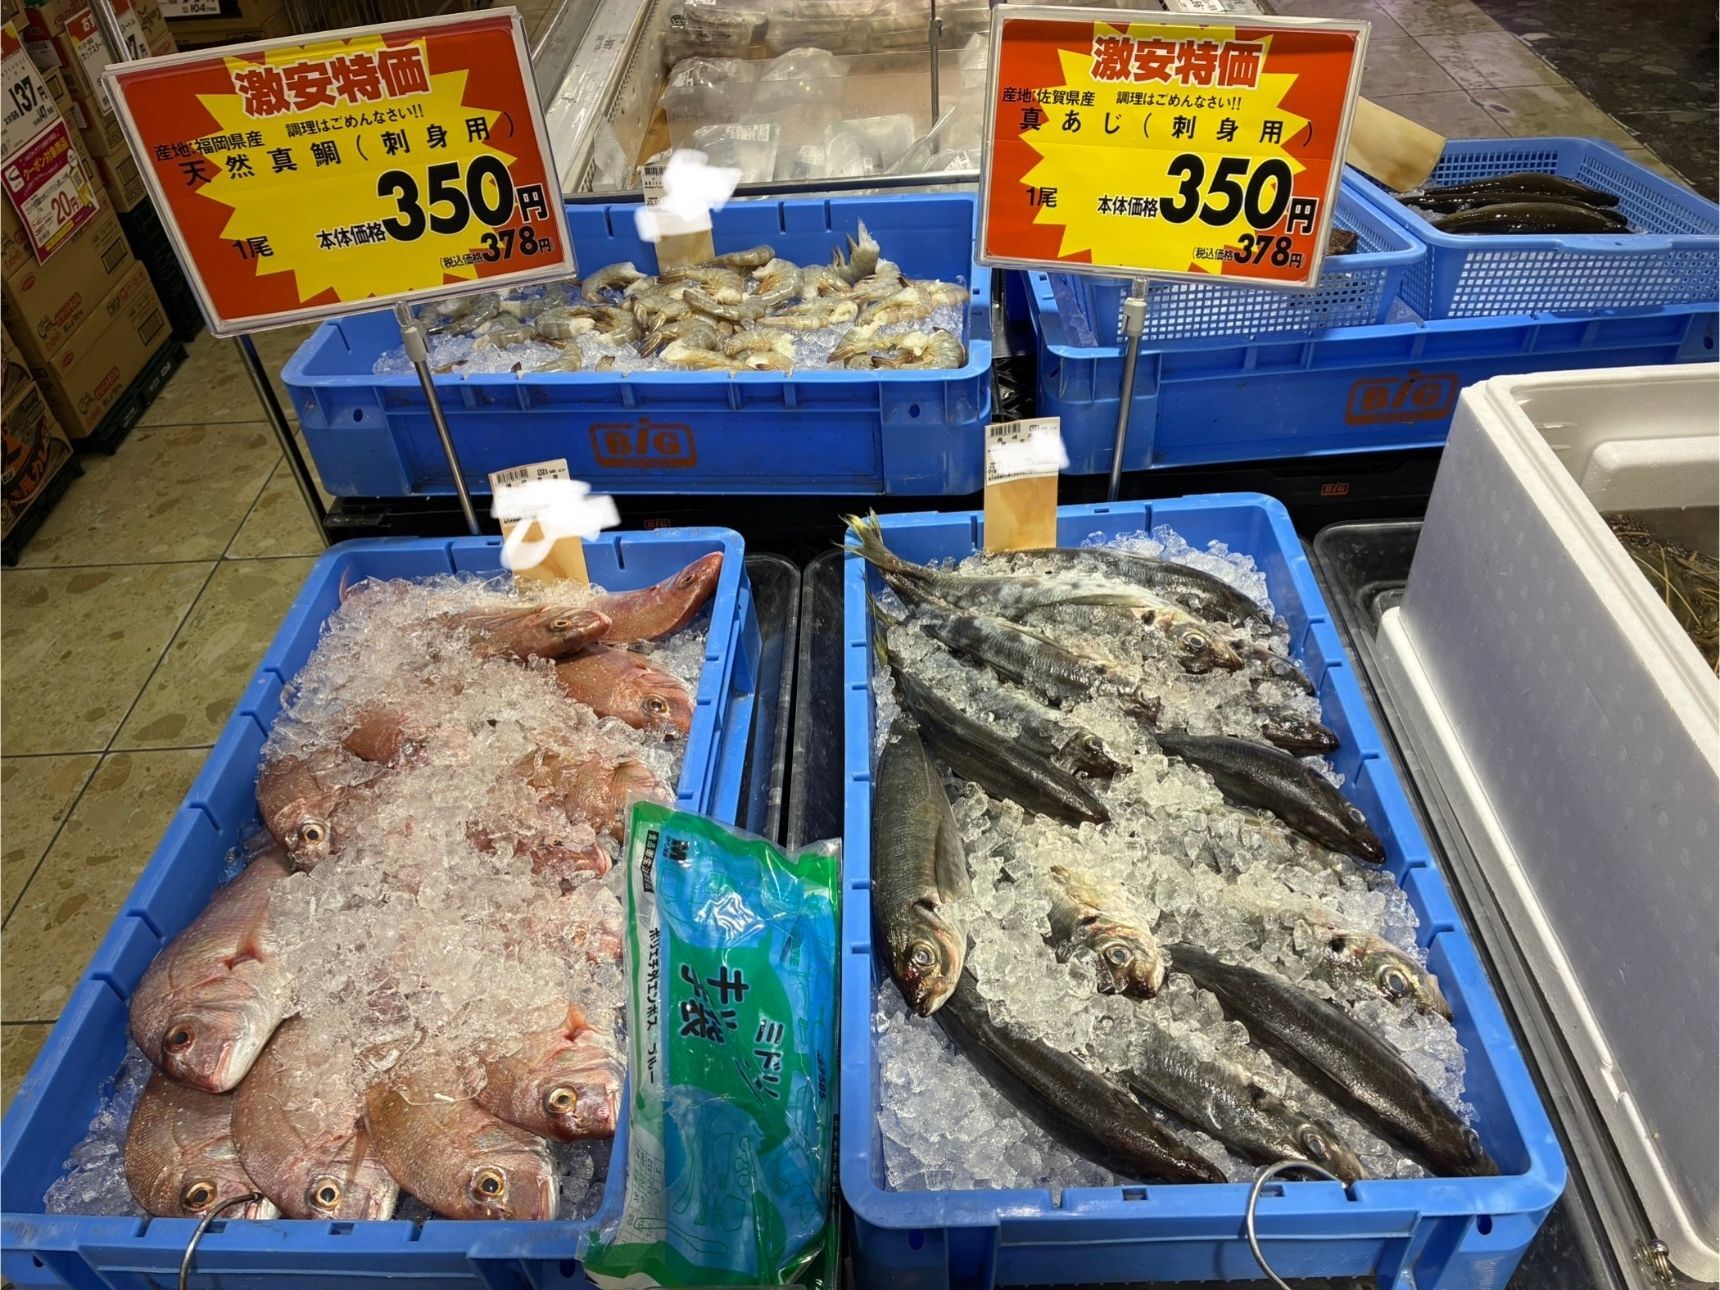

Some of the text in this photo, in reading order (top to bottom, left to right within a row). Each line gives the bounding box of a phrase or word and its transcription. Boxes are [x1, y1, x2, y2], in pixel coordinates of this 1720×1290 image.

[233, 47, 431, 118] 激安特価
[1090, 34, 1266, 91] 激安特価
[1025, 186, 1058, 208] 1尾
[232, 235, 274, 261] 1尾
[755, 1018, 784, 1099] ミドリ
